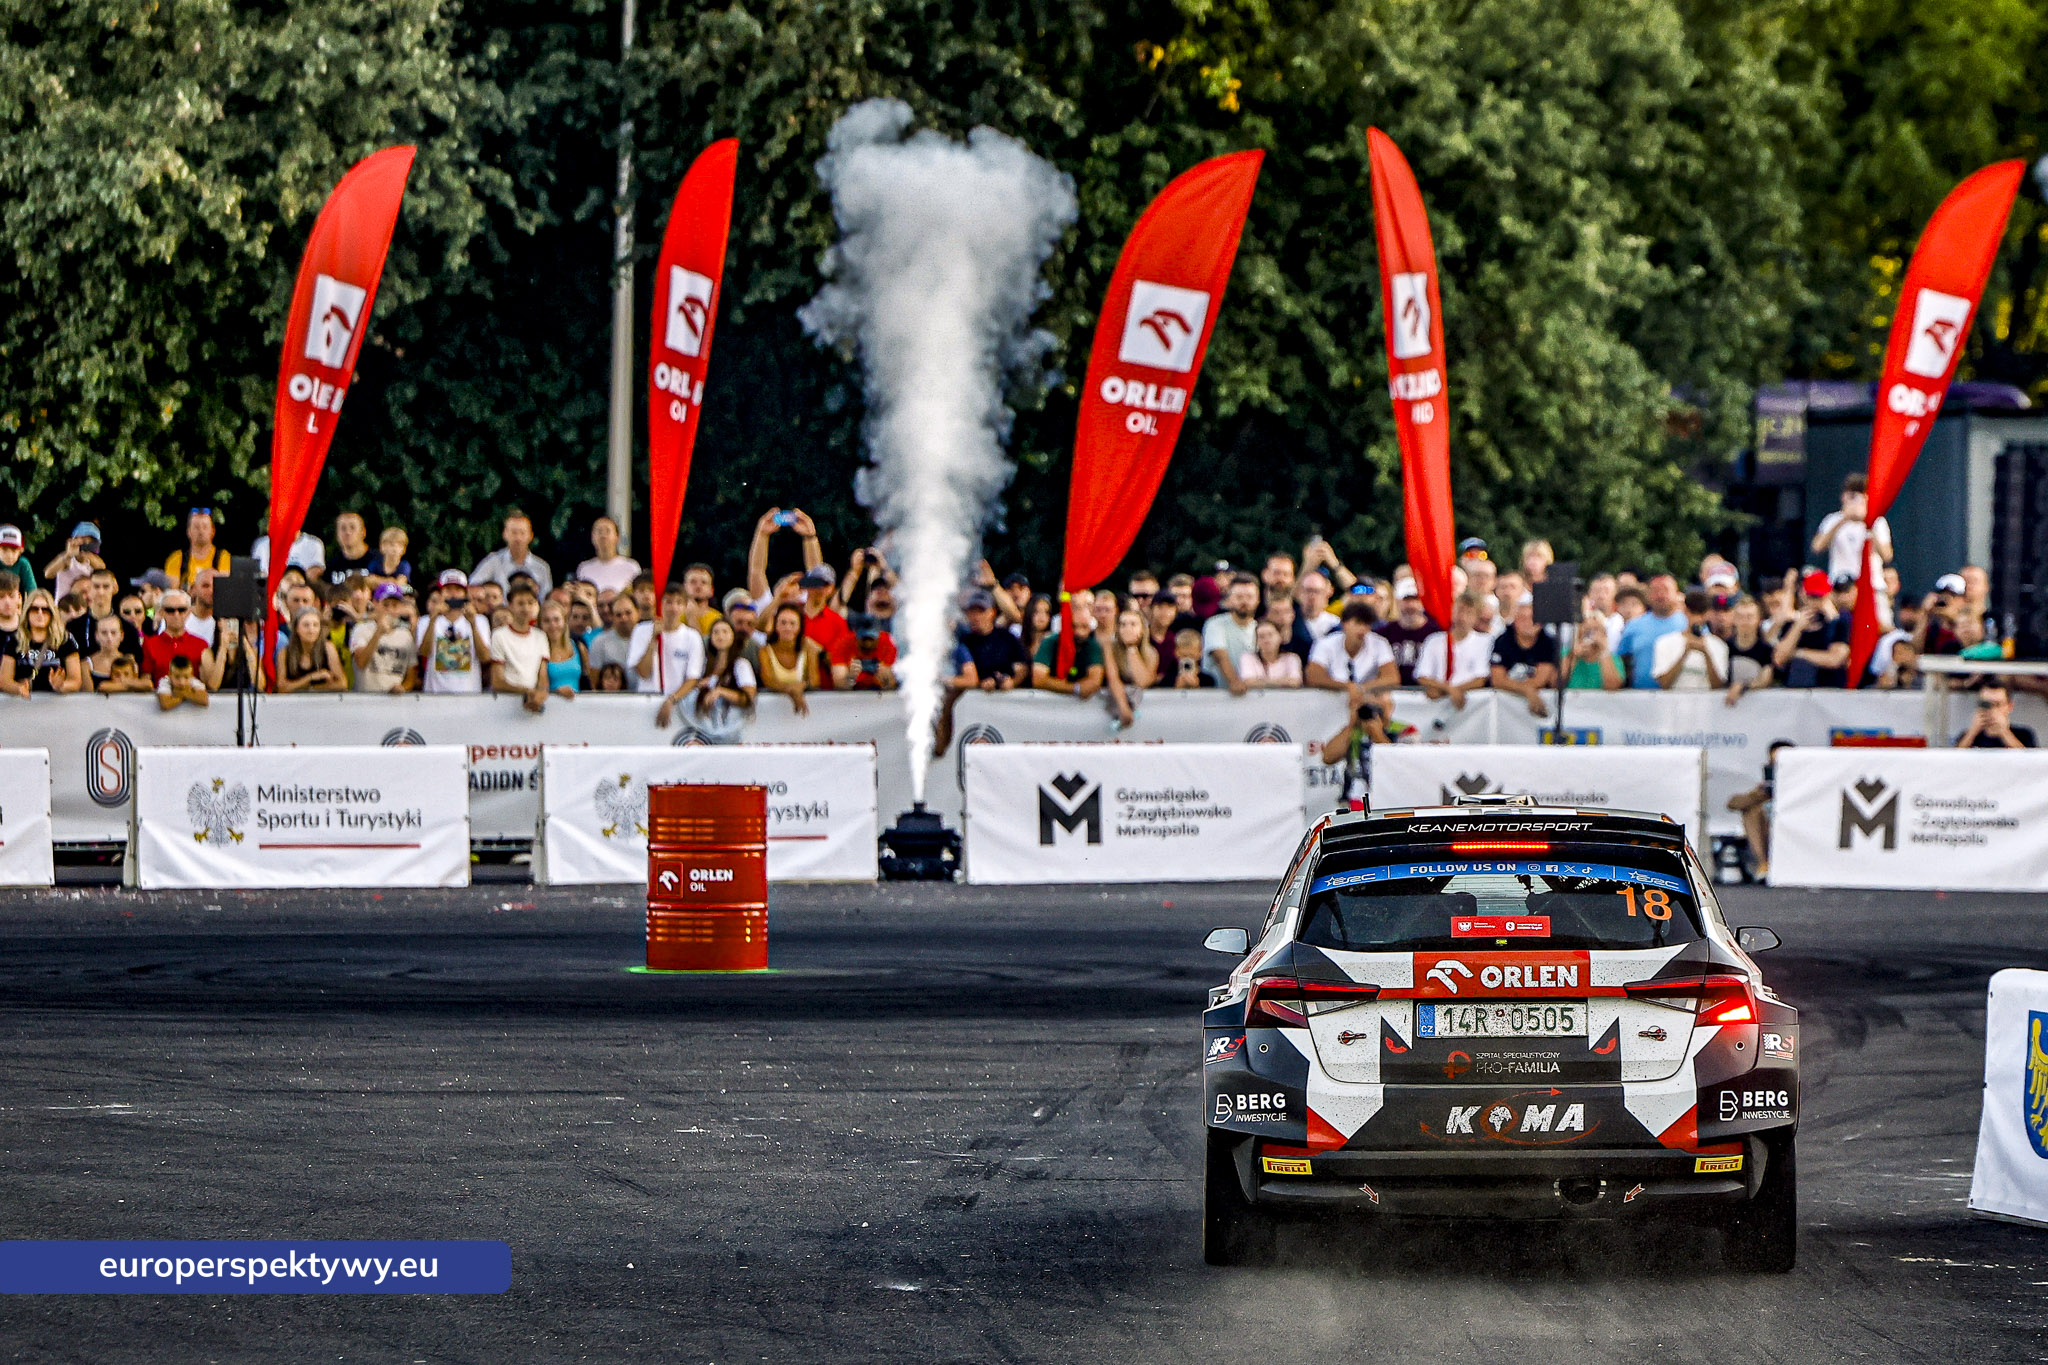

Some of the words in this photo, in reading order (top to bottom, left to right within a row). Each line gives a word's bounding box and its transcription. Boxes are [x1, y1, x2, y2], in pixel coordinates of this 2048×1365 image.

[468, 769, 524, 791] ADION
[257, 784, 381, 804] Ministerstwo
[767, 801, 829, 824] rystyki
[257, 809, 320, 832] Sportu
[325, 808, 331, 828] i
[336, 808, 422, 832] Turystyki
[1407, 822, 1593, 833] KEANEMOTORSPORT
[689, 868, 734, 882] ORLEN
[1410, 864, 1468, 874] FOLLOW
[1473, 863, 1492, 871] US
[1497, 863, 1516, 871] ON
[689, 882, 707, 892] OIL
[1616, 886, 1673, 921] 18
[1480, 965, 1579, 989] ORLEN
[1443, 1007, 1489, 1033] 14R
[1511, 1007, 1574, 1032] 0505
[1421, 1025, 1434, 1033] CZ
[1475, 1052, 1501, 1060] SZPITAL
[1476, 1061, 1561, 1074] PRO-FAMILIA
[1236, 1092, 1286, 1110] BERG
[1742, 1090, 1789, 1107] BERG
[1235, 1112, 1287, 1122] INWESTYCJE
[1742, 1110, 1790, 1120] INWESTYCJE
[1267, 1160, 1306, 1173] PIRELLI
[1699, 1158, 1740, 1171] PIRELLI
